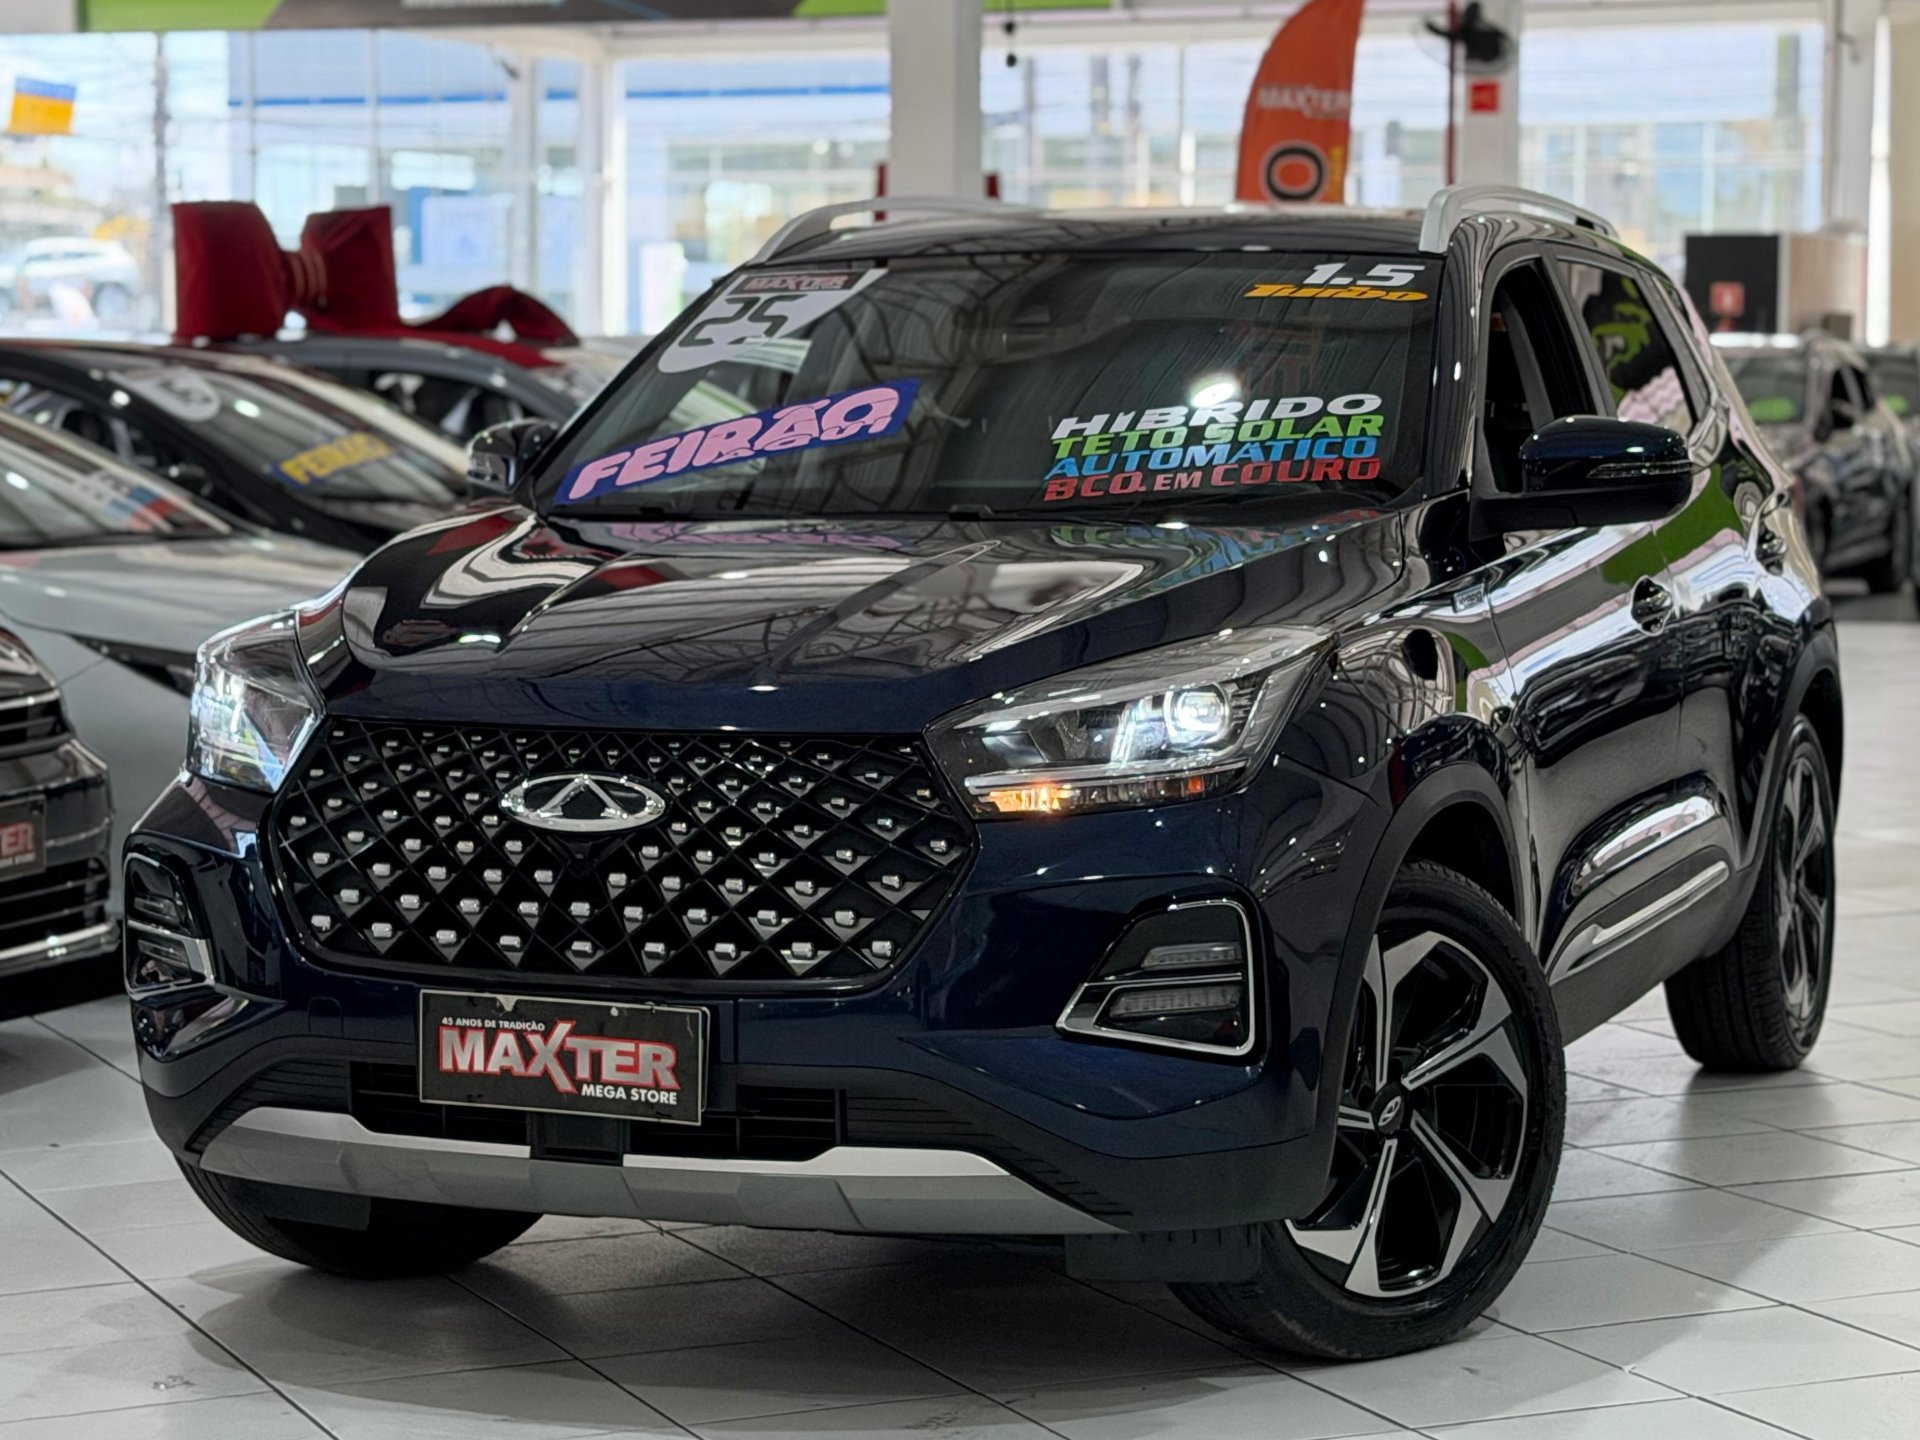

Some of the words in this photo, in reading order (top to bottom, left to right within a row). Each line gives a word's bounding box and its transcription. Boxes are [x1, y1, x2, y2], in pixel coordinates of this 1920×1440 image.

[743, 275, 849, 290] MAXTER
[1303, 262, 1425, 286] 1.5
[568, 387, 900, 500] FEIRÃO
[1052, 427, 1188, 460] TETO
[1202, 414, 1384, 445] SOLAR
[1153, 471, 1203, 491] EM
[1211, 458, 1381, 486] COURO
[455, 1018, 482, 1028] ANOS
[484, 1019, 497, 1029] DE
[438, 1018, 681, 1094] MAXTER
[581, 1083, 627, 1101] MEGA
[630, 1088, 678, 1105] STORE
